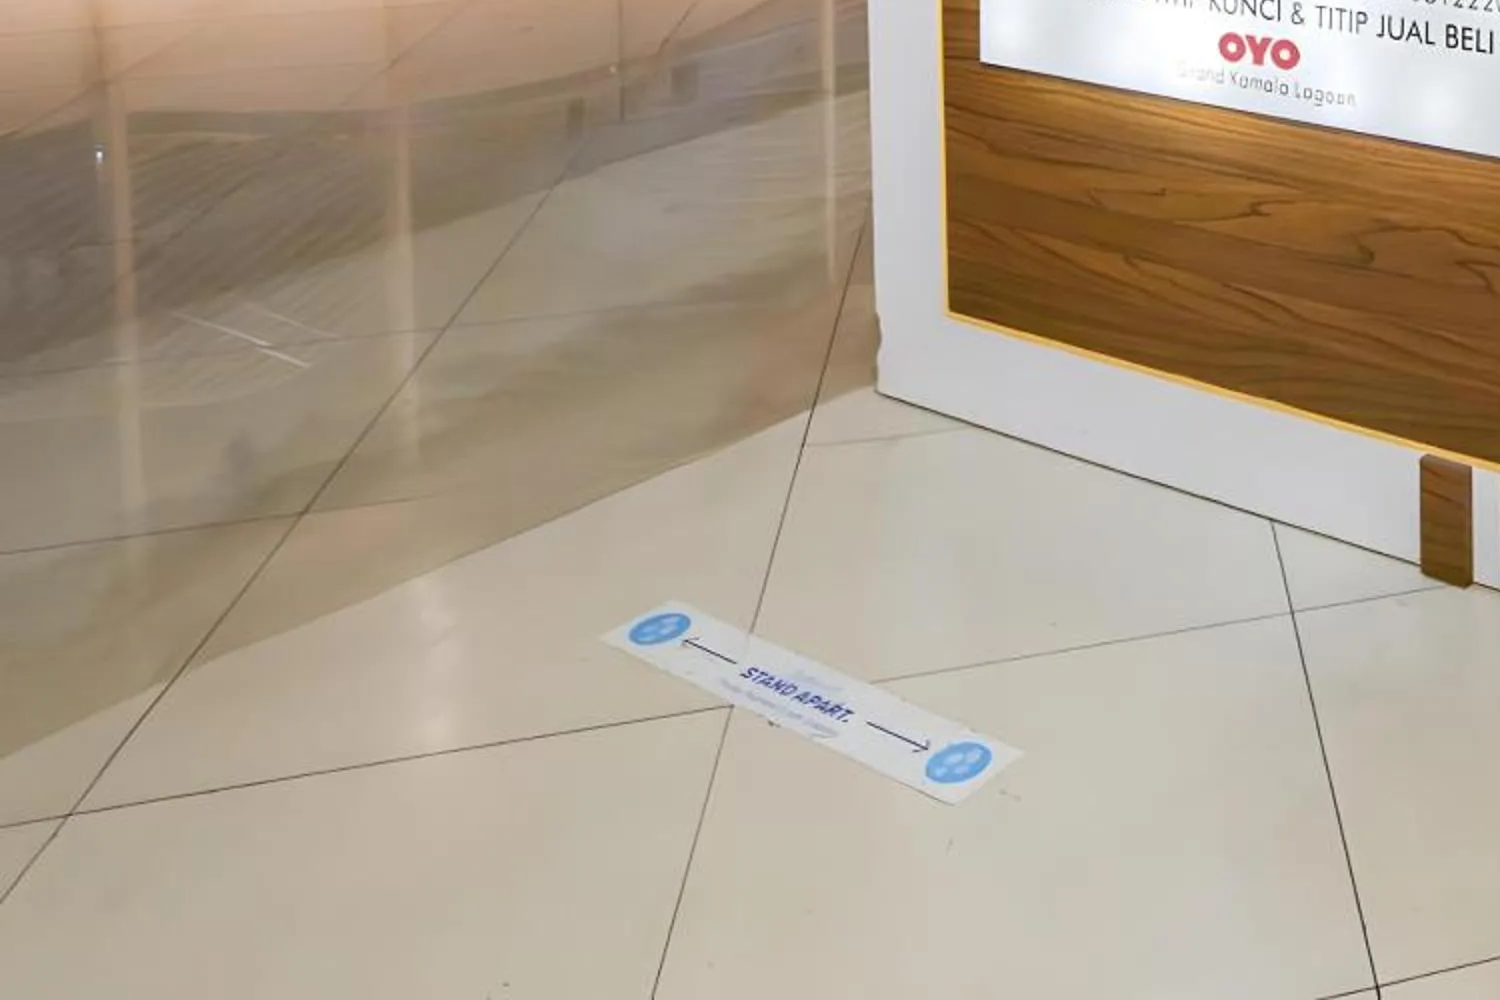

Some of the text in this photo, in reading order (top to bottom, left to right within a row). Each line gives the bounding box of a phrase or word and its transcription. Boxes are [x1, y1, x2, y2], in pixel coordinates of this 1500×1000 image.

[1290, 1, 1306, 26] &
[1315, 4, 1369, 35] TITIP
[1376, 13, 1436, 46] JUAL
[1444, 22, 1495, 55] BELI
[1217, 32, 1301, 70] OYO
[1175, 59, 1225, 85] rand
[739, 666, 798, 696] STAND
